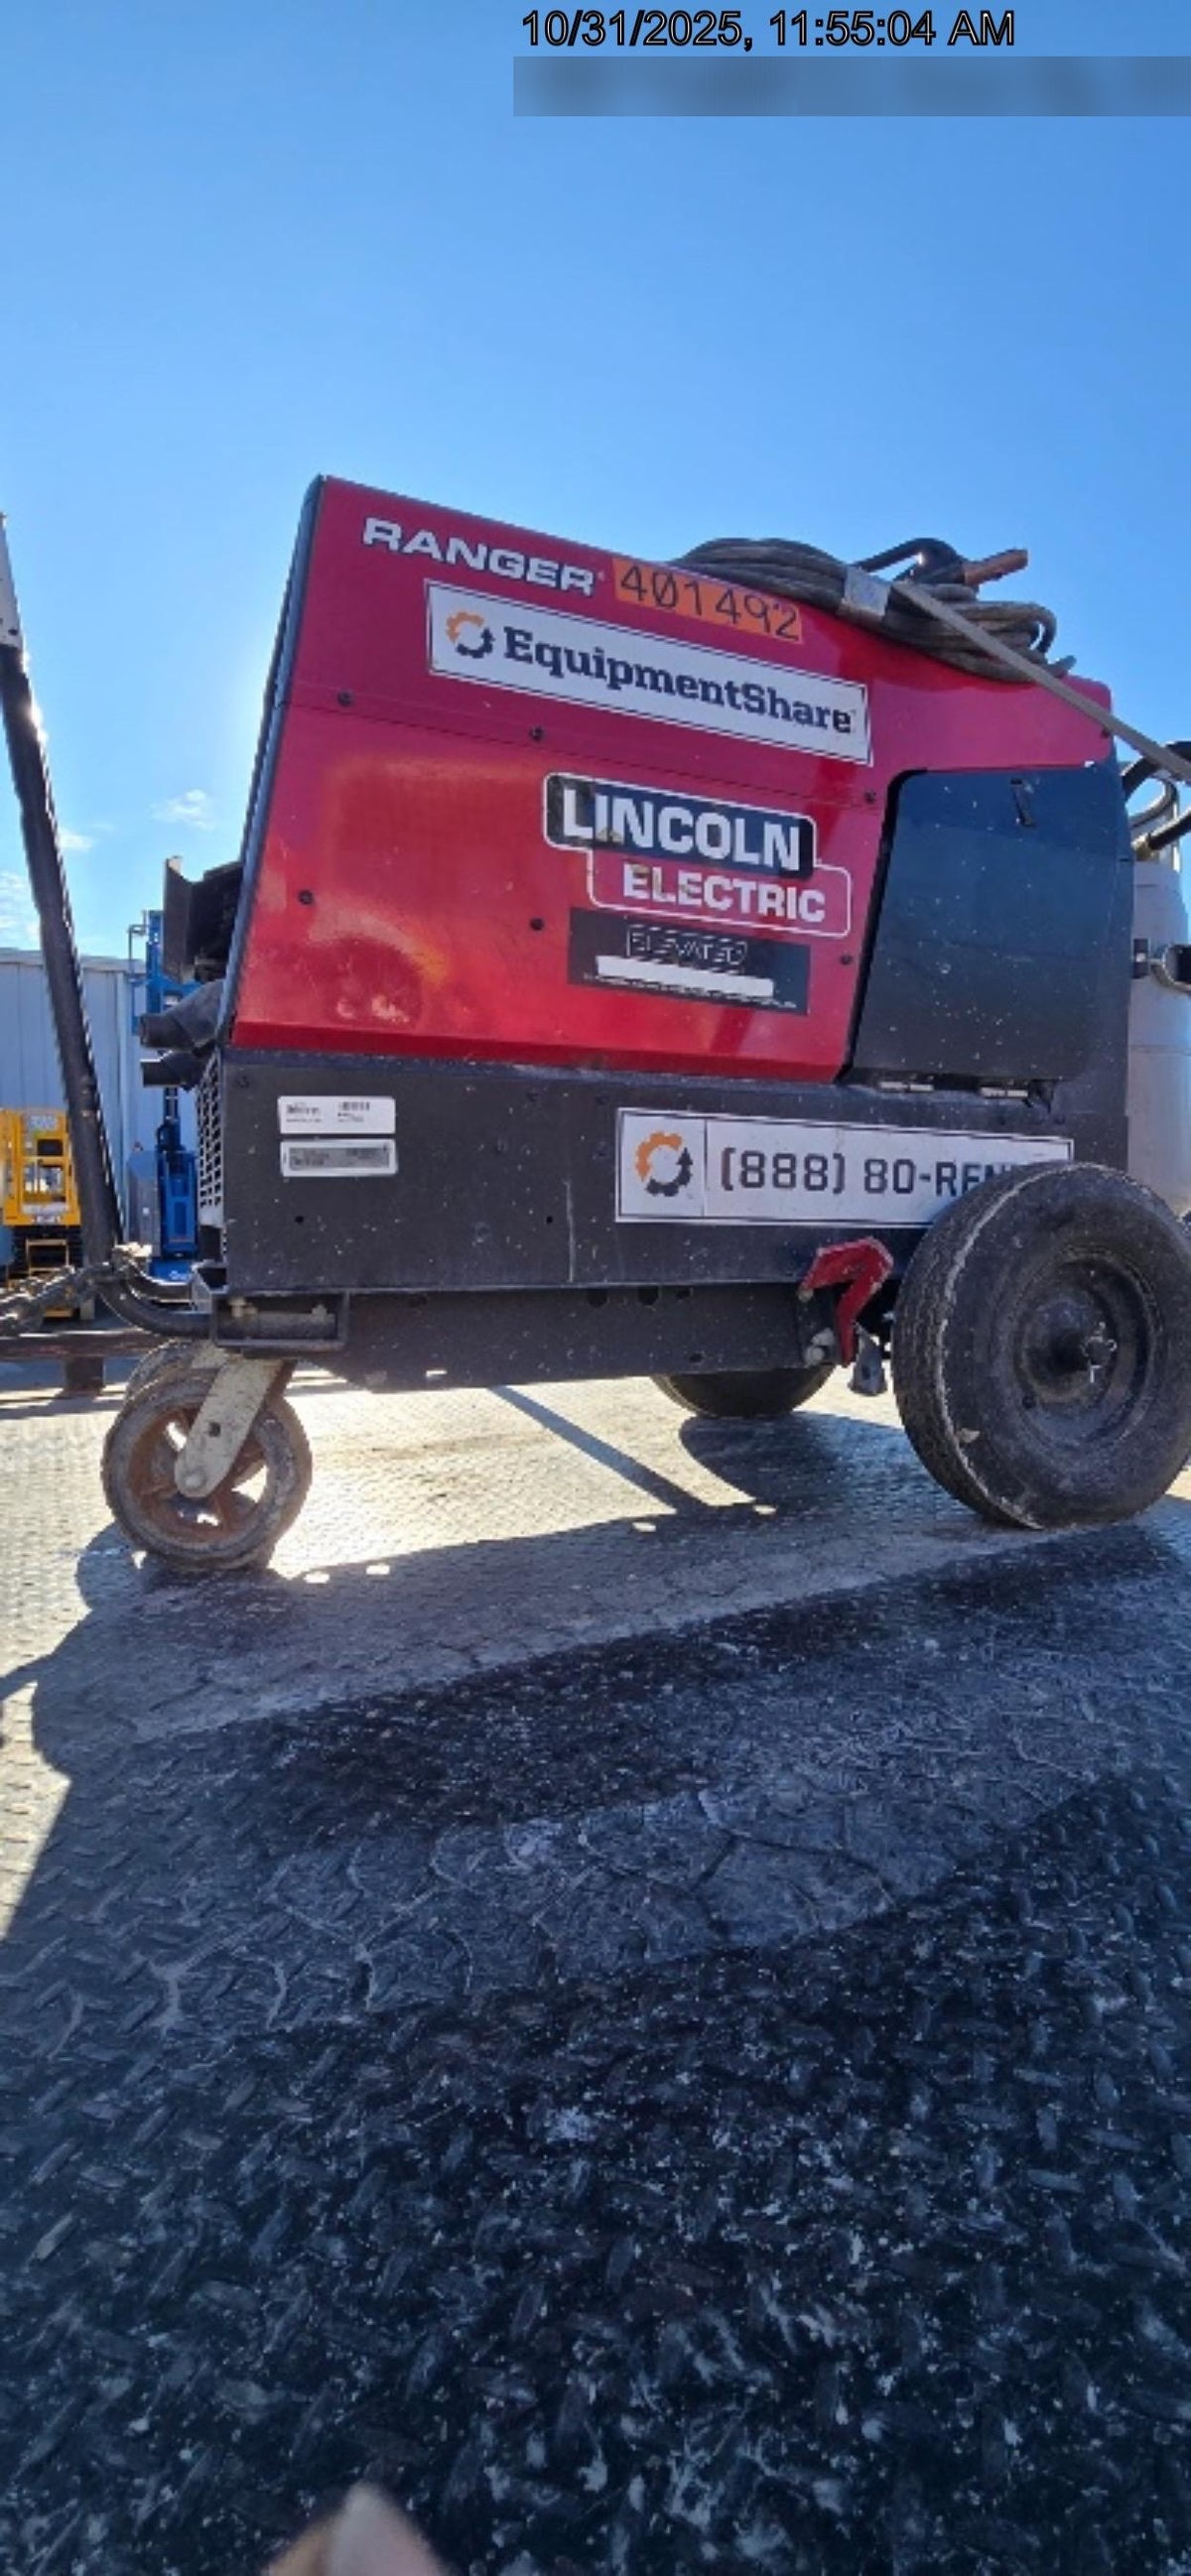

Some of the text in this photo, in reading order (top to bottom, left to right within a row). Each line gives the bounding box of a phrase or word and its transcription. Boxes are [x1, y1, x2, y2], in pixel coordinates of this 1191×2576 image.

[362, 517, 596, 595] RANGER
[620, 565, 800, 641] 401492
[503, 625, 852, 734] EquipmentShare
[563, 789, 800, 871] LINCOLN
[623, 863, 826, 923] ELECTRIC
[722, 1147, 846, 1195] (888)
